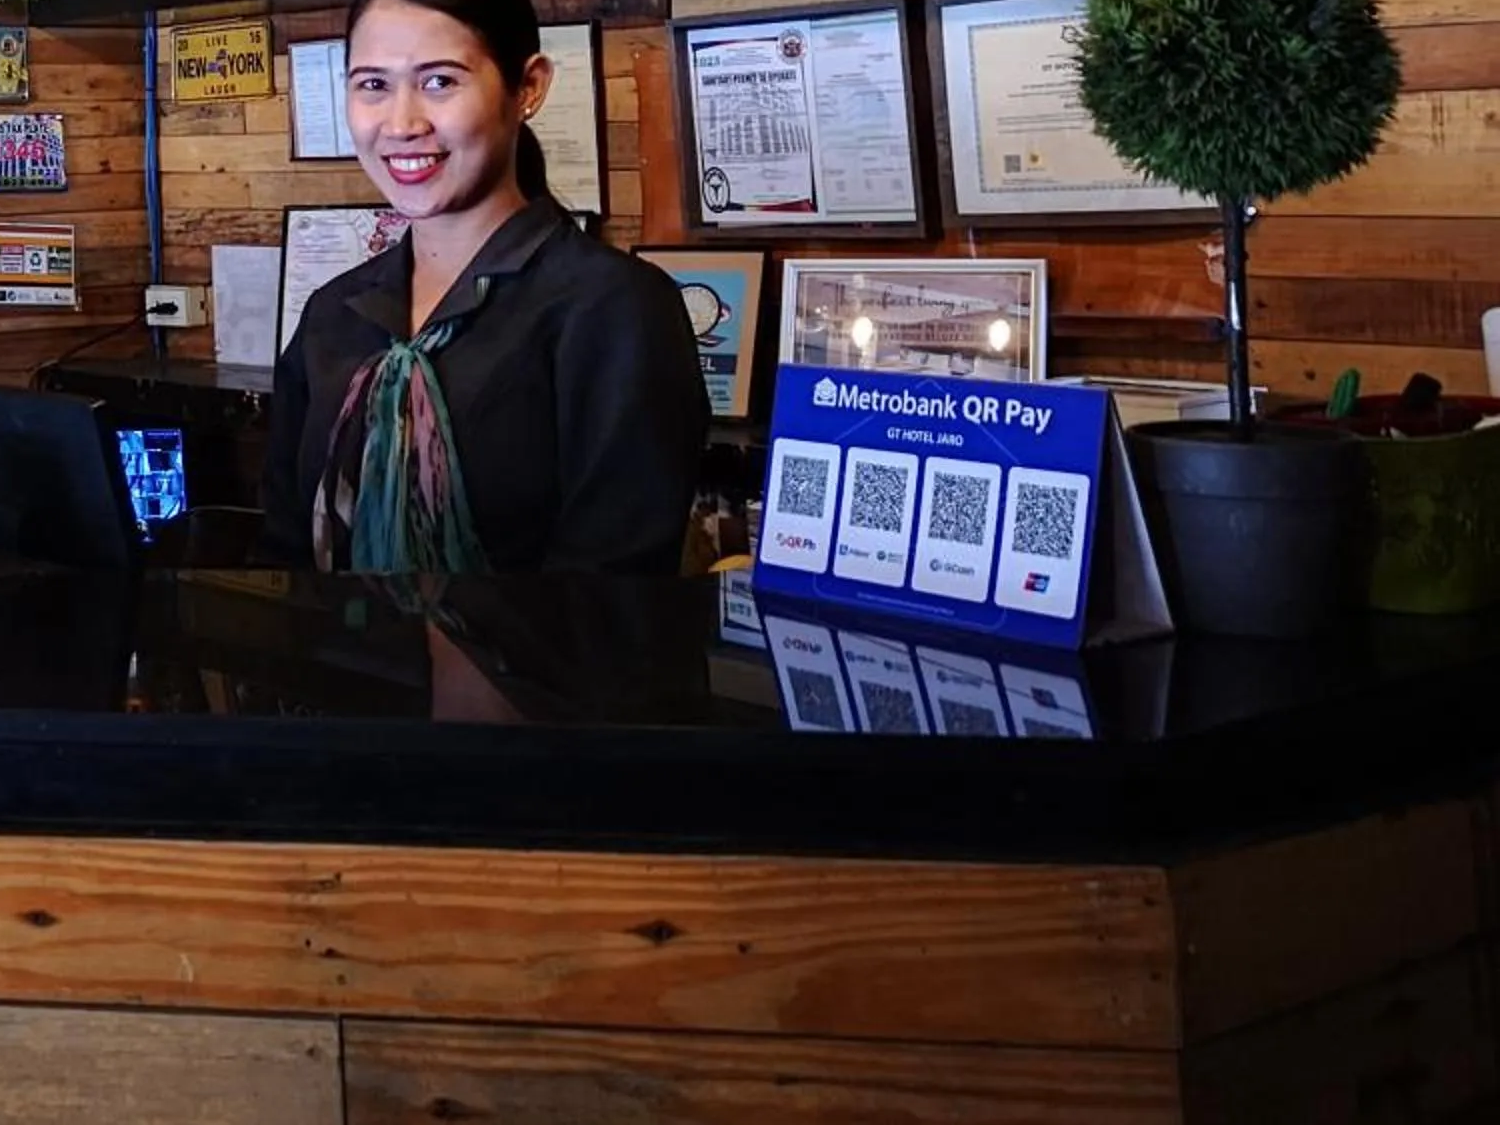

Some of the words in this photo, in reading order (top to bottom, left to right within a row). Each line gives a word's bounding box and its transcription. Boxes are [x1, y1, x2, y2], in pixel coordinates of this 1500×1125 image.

[177, 56, 207, 80] NEW
[227, 51, 265, 76] YORK
[838, 383, 957, 419] Metrobank
[962, 395, 999, 424] QR
[1004, 399, 1052, 435] Pay
[887, 426, 901, 439] GT
[902, 427, 934, 444] HOTEL
[937, 432, 964, 447] JARO
